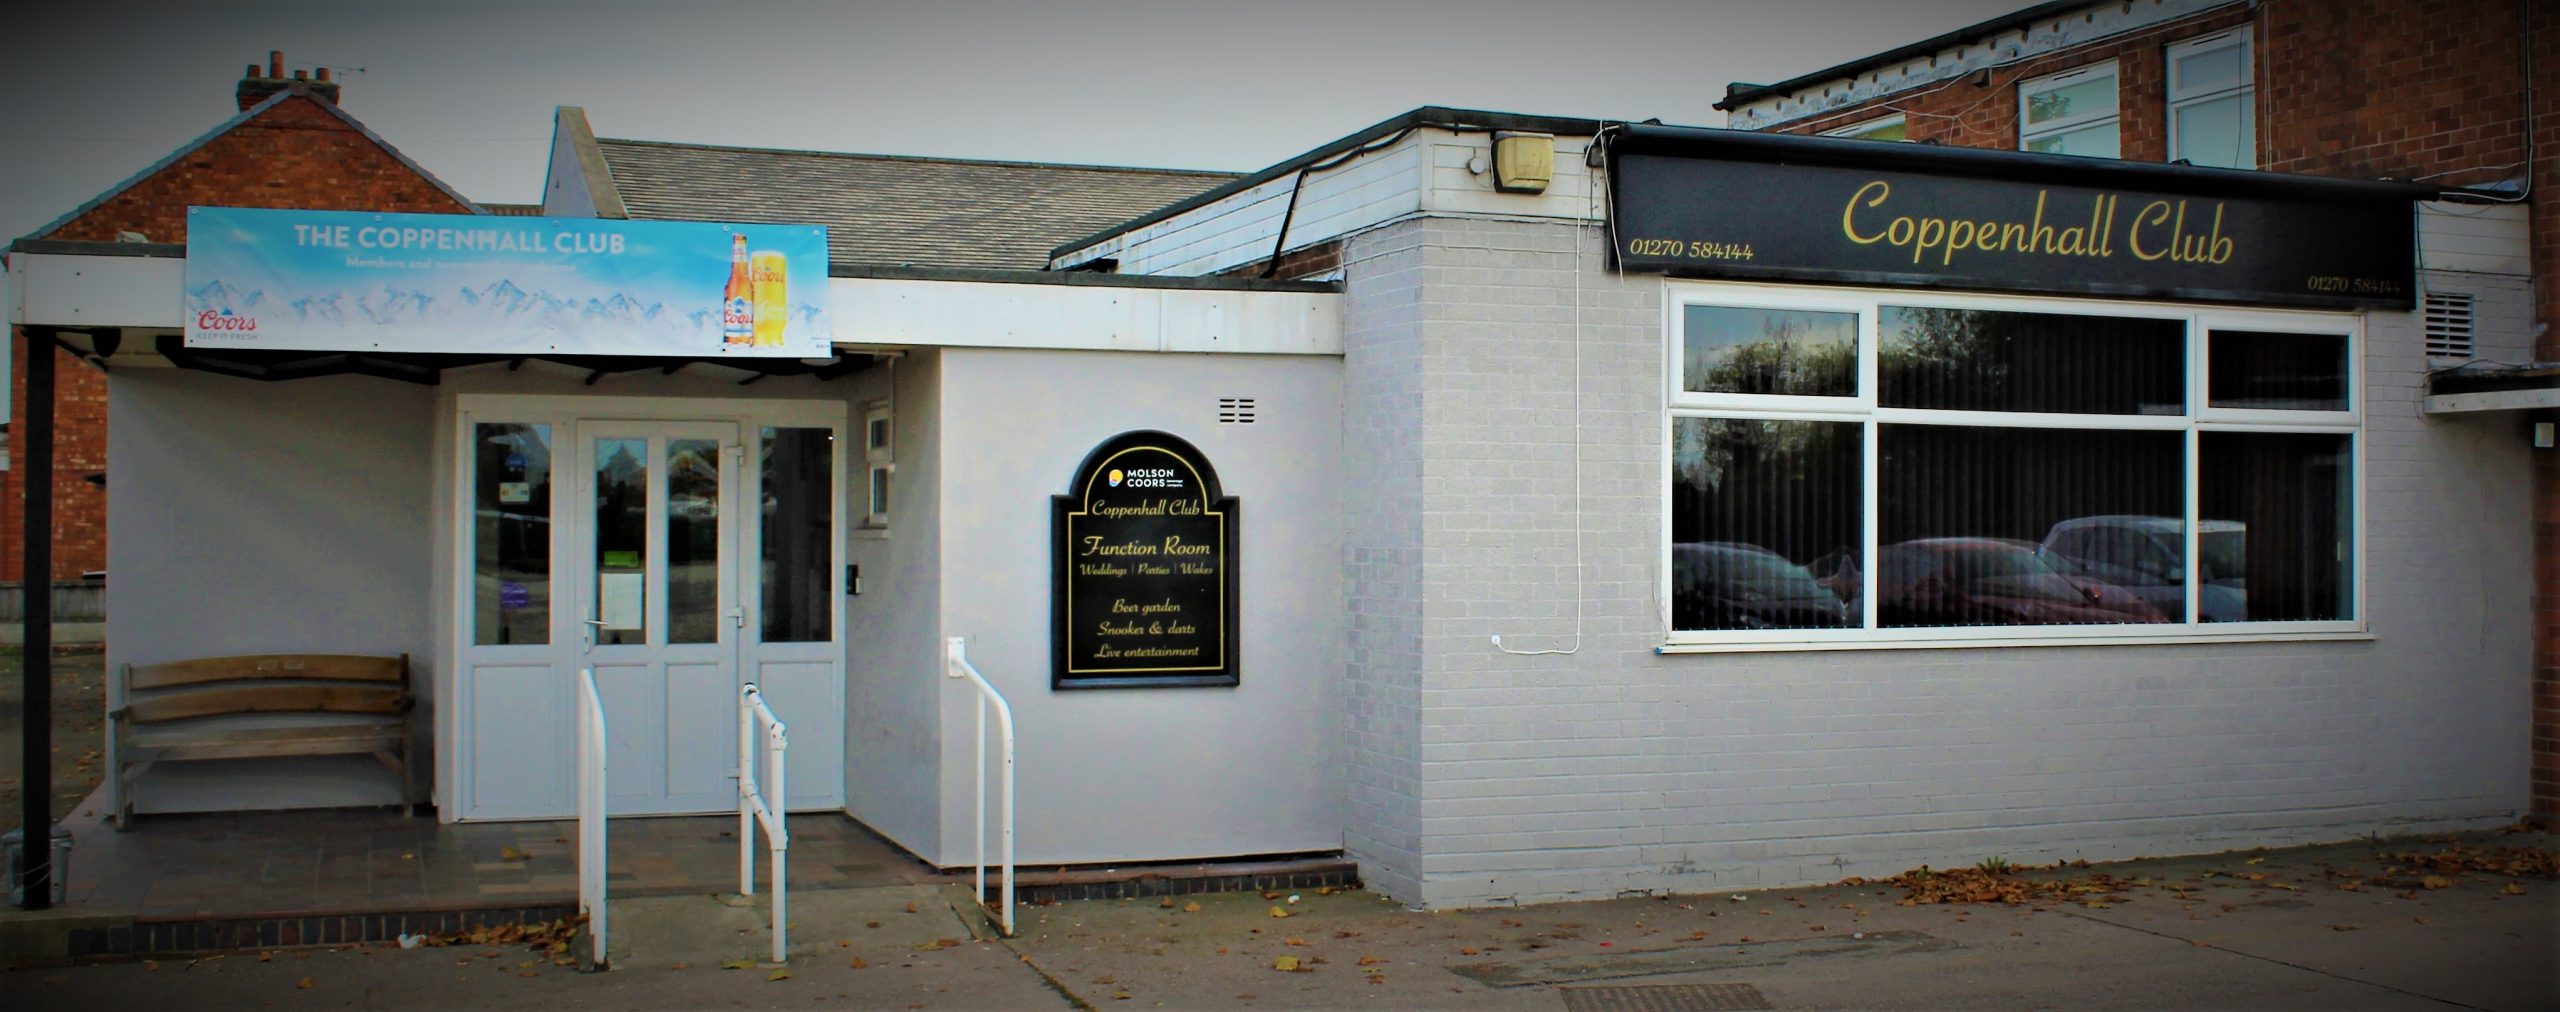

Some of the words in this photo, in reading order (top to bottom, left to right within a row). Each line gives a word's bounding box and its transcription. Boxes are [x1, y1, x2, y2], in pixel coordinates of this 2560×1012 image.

[1843, 181, 2117, 265] Coppenhall
[2129, 199, 2234, 264] Club
[294, 224, 350, 248] THE
[357, 226, 547, 252] COPPENHALL
[554, 231, 625, 254] CLUB
[1630, 238, 1684, 257] 01270
[1688, 241, 1754, 260] 584144
[346, 256, 404, 269] Members
[2308, 275, 2349, 292] 01270
[2352, 278, 2400, 294] 584144
[198, 309, 257, 331] Coors
[1127, 469, 1174, 478] MOLSON
[1127, 479, 1165, 488] COORS
[1092, 498, 1167, 519] Coppenhall
[1169, 498, 1200, 516] Club
[1081, 535, 1157, 556] Function
[1163, 535, 1211, 555] Room
[1080, 563, 1127, 577] Weddings
[1138, 562, 1170, 575] Parties
[1179, 562, 1213, 575] Wakes
[1112, 598, 1139, 613] Beer
[1142, 597, 1181, 616] garden
[1097, 621, 1144, 635] Snooker
[1148, 621, 1164, 635] &
[1168, 619, 1196, 634] darts
[1093, 643, 1121, 658] Live
[1124, 646, 1199, 658] entertainment
